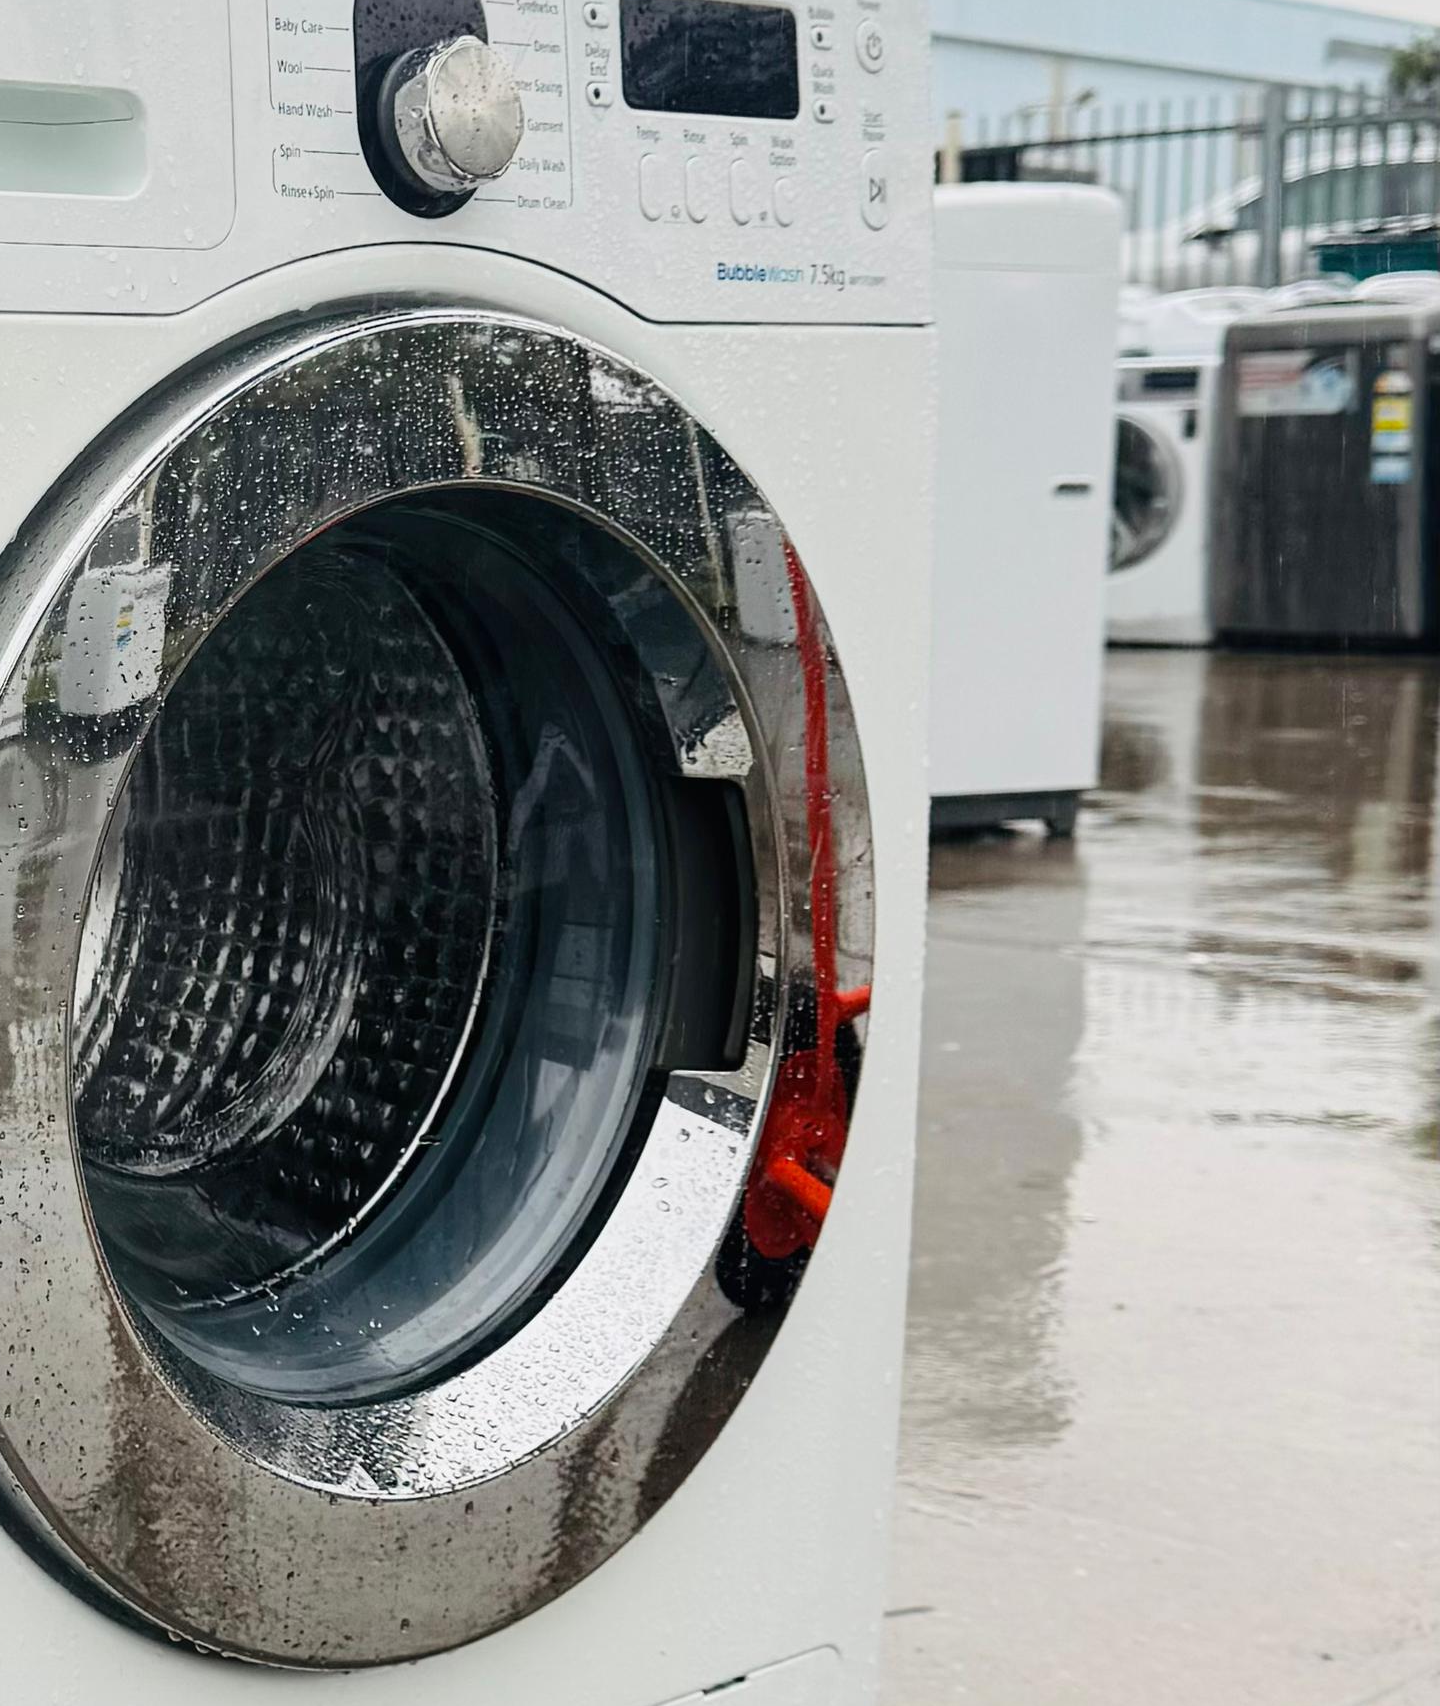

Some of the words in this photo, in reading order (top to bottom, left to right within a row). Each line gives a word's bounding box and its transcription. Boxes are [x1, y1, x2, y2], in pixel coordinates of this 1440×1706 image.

[275, 17, 299, 36] Baby
[301, 20, 323, 34] Care
[585, 43, 610, 62] Delay
[277, 60, 303, 74] Wool
[590, 61, 608, 76] End
[278, 102, 304, 116] Hand
[306, 104, 333, 119] Wash
[280, 144, 301, 161] Spin
[810, 263, 846, 292] 7.5kg
